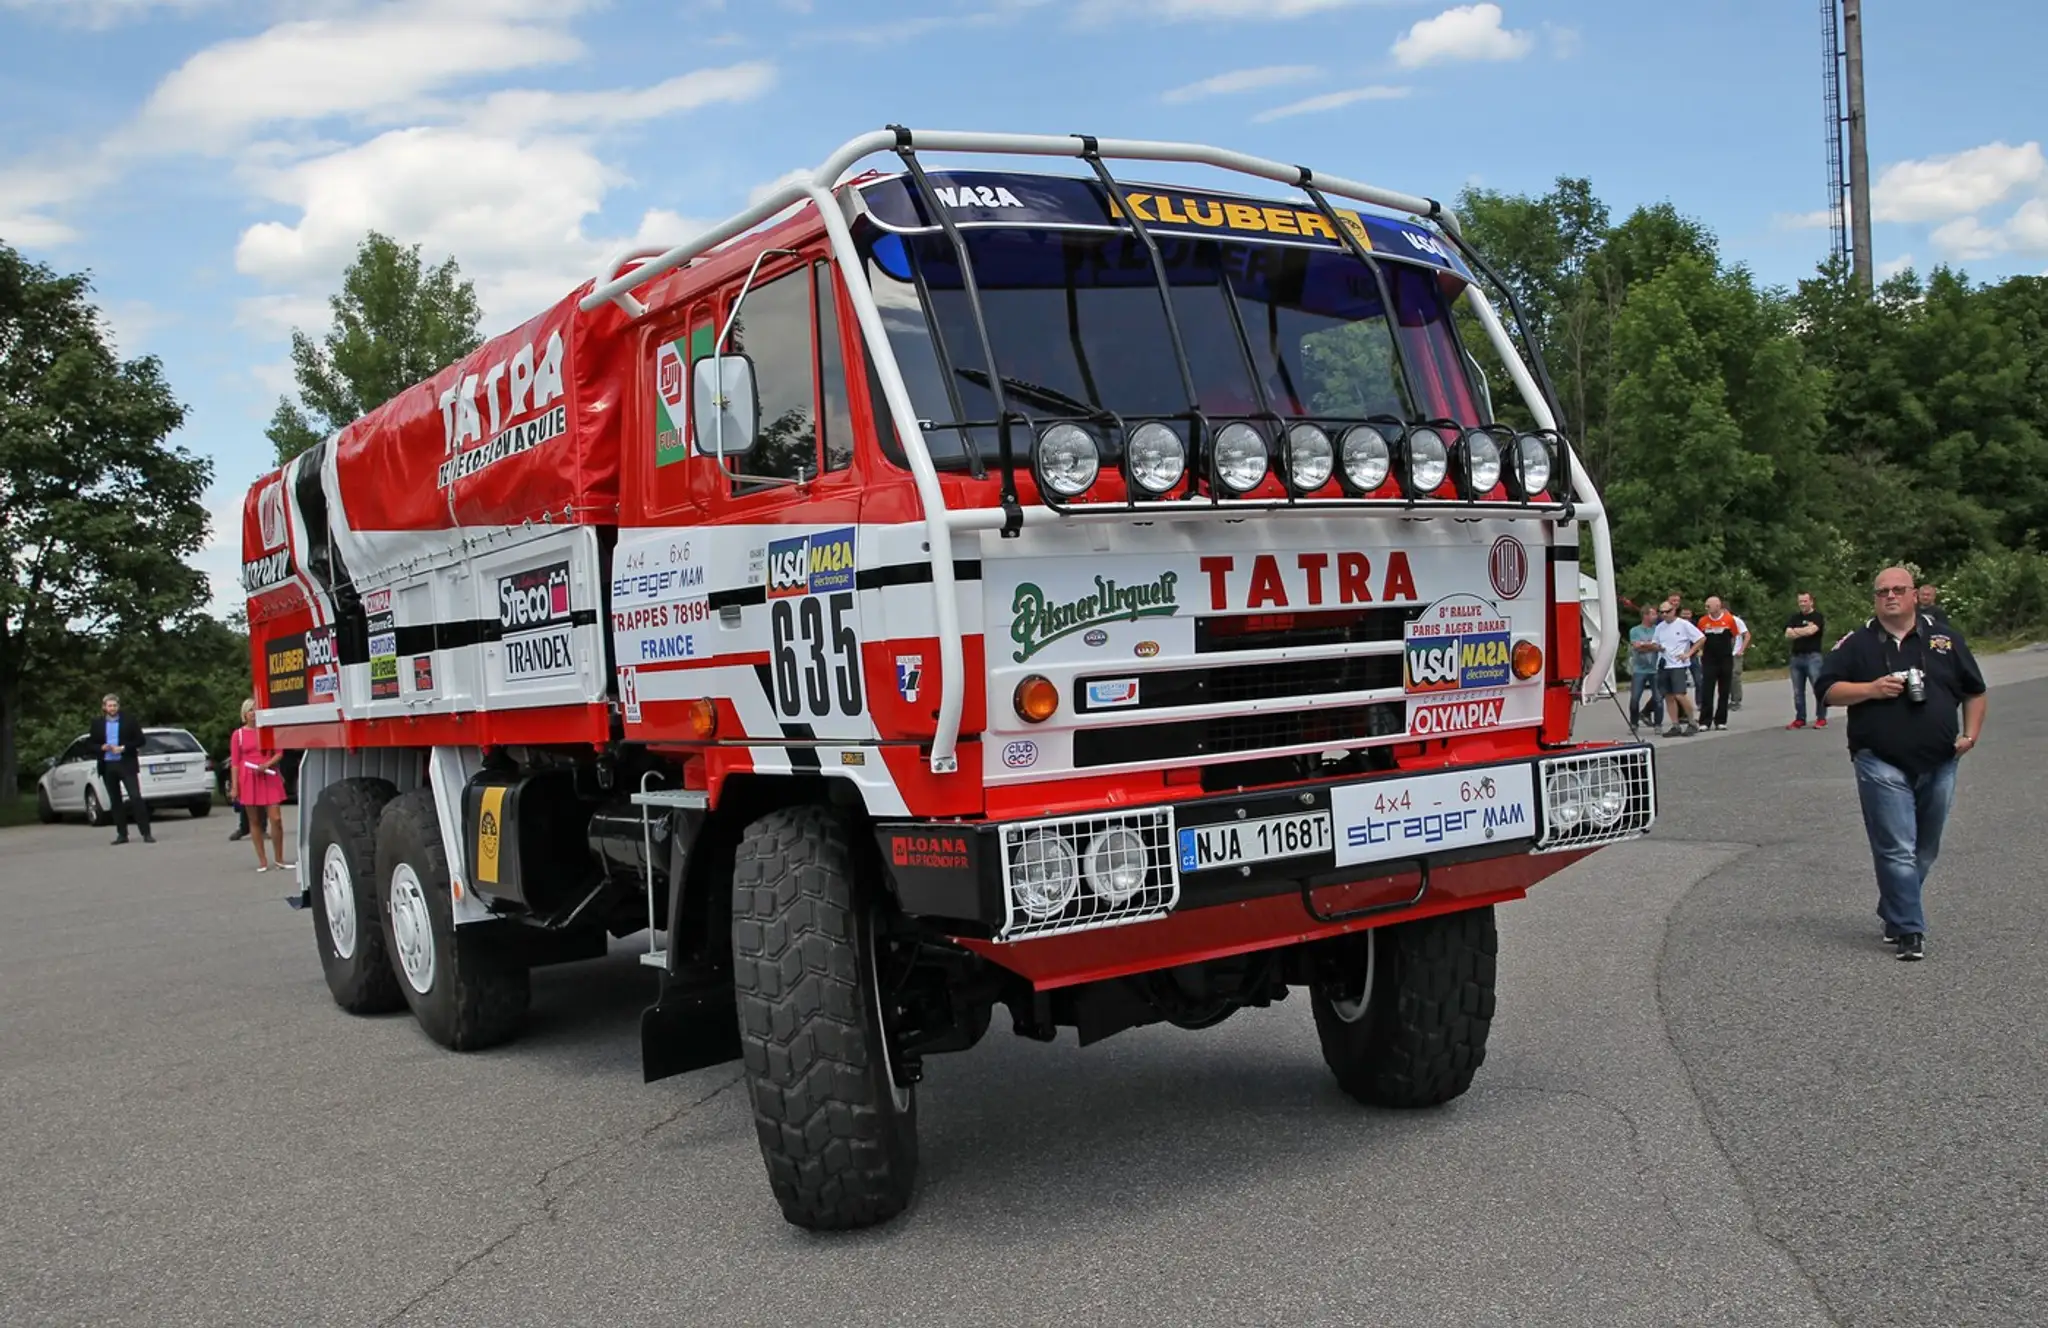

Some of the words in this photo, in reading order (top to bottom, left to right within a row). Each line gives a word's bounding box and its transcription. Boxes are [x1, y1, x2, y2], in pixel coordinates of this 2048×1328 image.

[934, 185, 1025, 208] NASA
[439, 329, 564, 457] TATRA
[626, 552, 644, 570] 4x4
[669, 541, 691, 564] 6x6
[810, 541, 854, 573] NASA
[613, 570, 678, 598] strager
[679, 565, 704, 588] MAM
[1200, 551, 1418, 610] TATRA
[501, 578, 548, 627] Steco
[612, 605, 668, 633] TRAPPES
[673, 600, 710, 625] 78191
[1011, 582, 1099, 664] Pilsner
[1094, 571, 1178, 622] Urquell
[1451, 605, 1482, 618] RALLYE
[506, 633, 572, 674] TRANDEX
[641, 635, 694, 660] FRANCE
[771, 592, 863, 717] 635
[1461, 640, 1509, 667] NASA
[1466, 667, 1504, 681] électronique
[1415, 701, 1499, 735] OLYMPIA
[1008, 742, 1033, 754] club
[1374, 789, 1411, 814] 4x4
[1460, 778, 1497, 802] 6x6
[1197, 828, 1242, 865] NJA
[1258, 816, 1326, 854] 1168T
[1347, 809, 1477, 846] strager
[1483, 803, 1525, 829] MAM
[908, 836, 968, 854] LOANA
[1183, 855, 1195, 866] CZ
